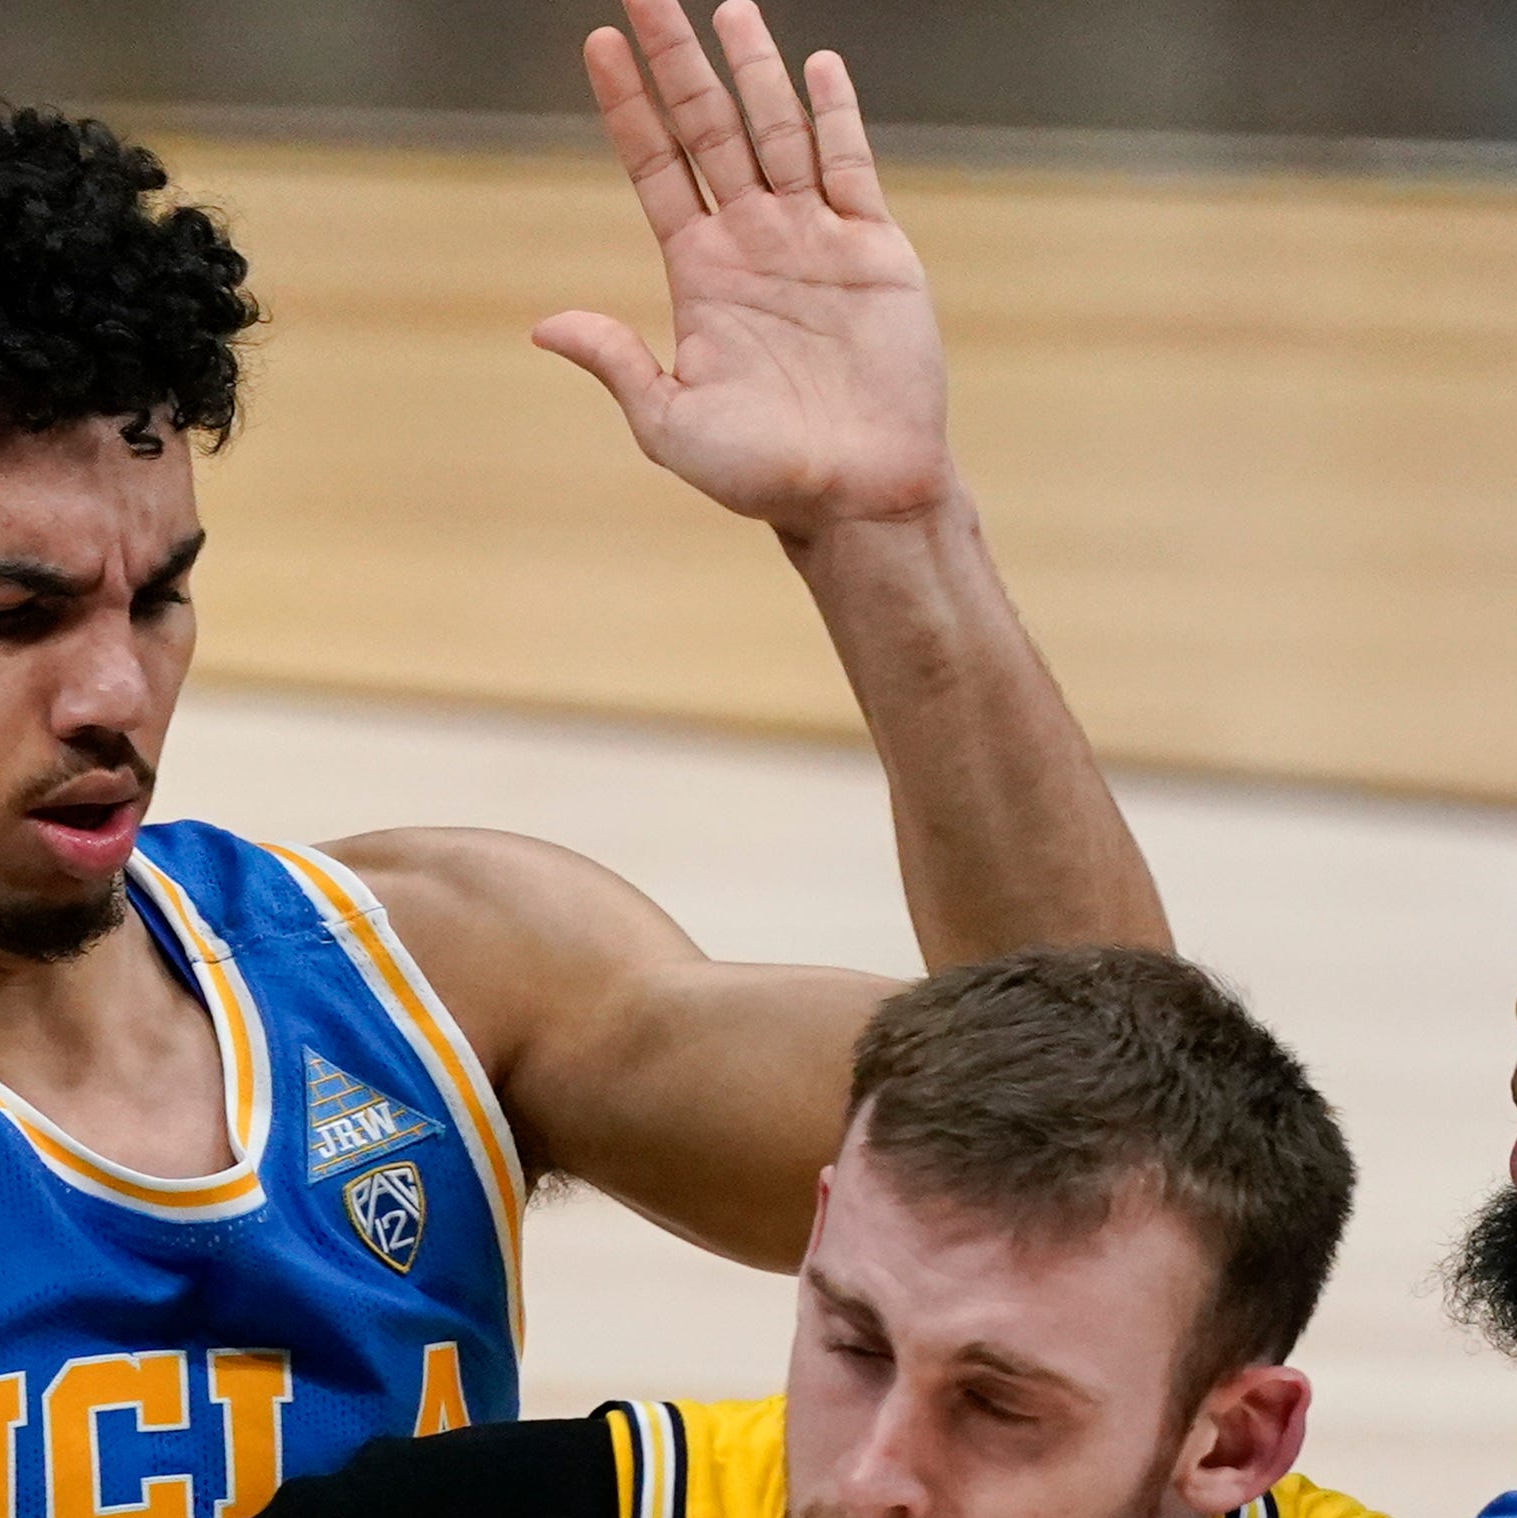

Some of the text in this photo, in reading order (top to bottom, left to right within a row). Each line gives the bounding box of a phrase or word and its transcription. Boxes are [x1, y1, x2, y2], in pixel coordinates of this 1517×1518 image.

[314, 1101, 398, 1159] JRW
[350, 1167, 420, 1238] PAC
[374, 1209, 416, 1254] 12
